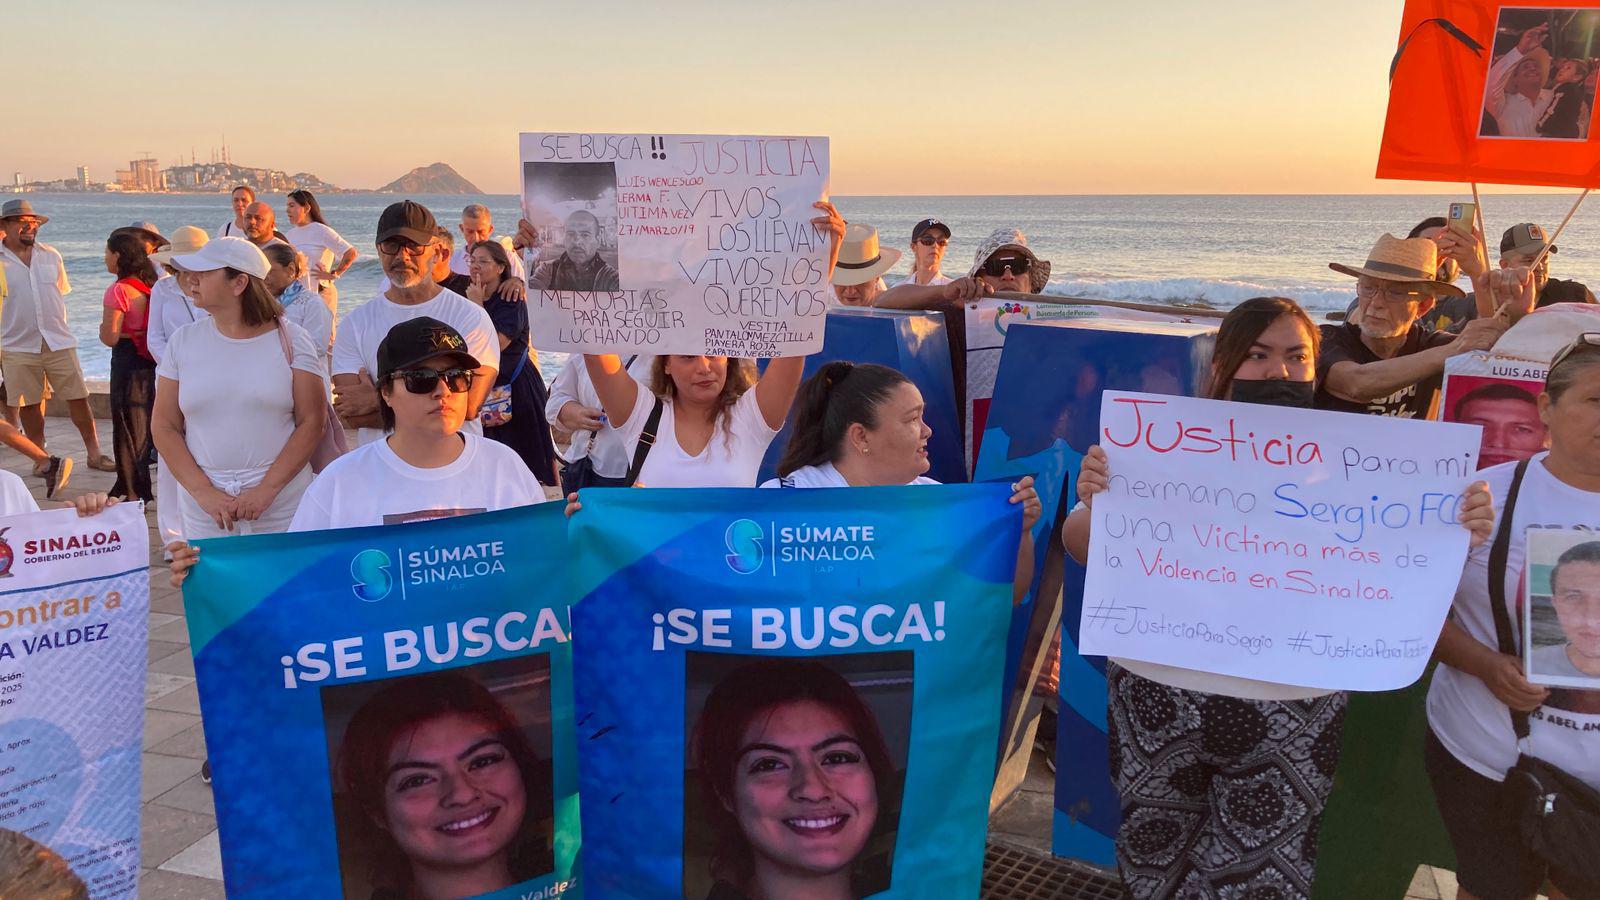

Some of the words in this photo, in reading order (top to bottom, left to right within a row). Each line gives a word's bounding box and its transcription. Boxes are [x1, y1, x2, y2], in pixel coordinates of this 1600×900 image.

[541, 135, 572, 160] SE
[580, 134, 643, 160] BUSCA
[680, 138, 820, 177] JUSTICIA
[617, 175, 646, 188] LUIS
[617, 192, 652, 203] LERMA
[677, 186, 781, 220] VIVOS
[671, 208, 689, 220] VEZ
[678, 257, 774, 286] VIVOS
[781, 257, 823, 286] LOS
[703, 285, 826, 318] QUEREMOS
[573, 310, 610, 327] PARA
[614, 310, 685, 329] SEGUIR
[558, 328, 661, 345] LUCHANDO
[749, 342, 777, 351] ROJA
[704, 348, 741, 357] ZAPATOS
[744, 350, 782, 358] NEGROS
[1492, 366, 1520, 377] LUIS
[1104, 398, 1323, 465] Justicia
[1342, 447, 1420, 481] para
[1435, 453, 1470, 477] mi
[1274, 483, 1411, 543] Sergio
[24, 530, 121, 555] SINALOA
[780, 522, 875, 544] SÚMATE
[24, 552, 71, 565] GOBIERNO
[73, 549, 89, 558] DEL
[91, 544, 122, 555] ESTADO
[407, 540, 505, 568] SÚMATE
[781, 545, 875, 562] SINALOA
[1104, 545, 1122, 568] la
[1136, 547, 1236, 584] Violencia
[1395, 544, 1428, 568] de
[410, 559, 506, 585] SINALOA
[104, 591, 121, 610] a
[652, 609, 732, 651] ¡SE
[751, 600, 946, 650] BUSCA!
[22, 622, 109, 656] VALDEZ
[280, 637, 366, 689] ¡SE
